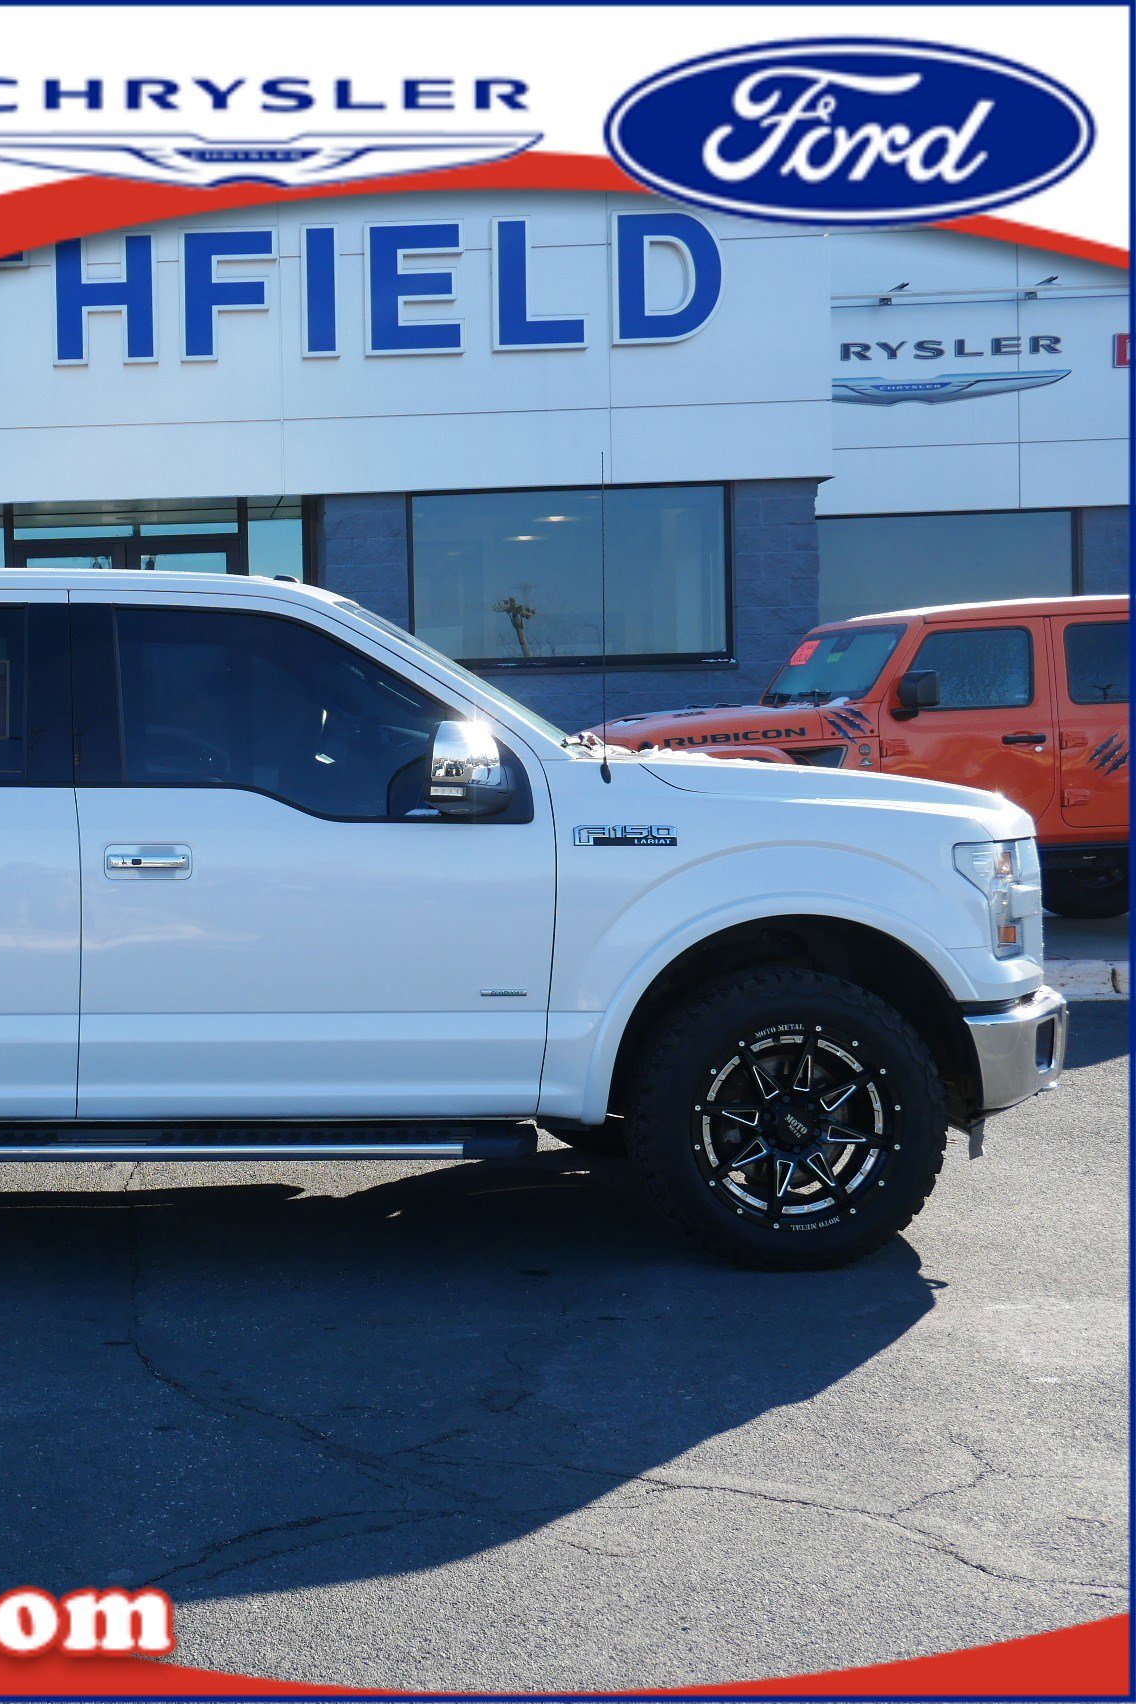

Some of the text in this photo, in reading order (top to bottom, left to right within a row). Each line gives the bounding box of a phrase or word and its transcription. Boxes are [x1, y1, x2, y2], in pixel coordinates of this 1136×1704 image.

[879, 383, 942, 392] CHRYSLER
[663, 727, 806, 748] RUBICON
[754, 1023, 804, 1039] MOTO METAL
[784, 1113, 808, 1135] MOTO
[790, 1215, 841, 1231] MOTO METAL
